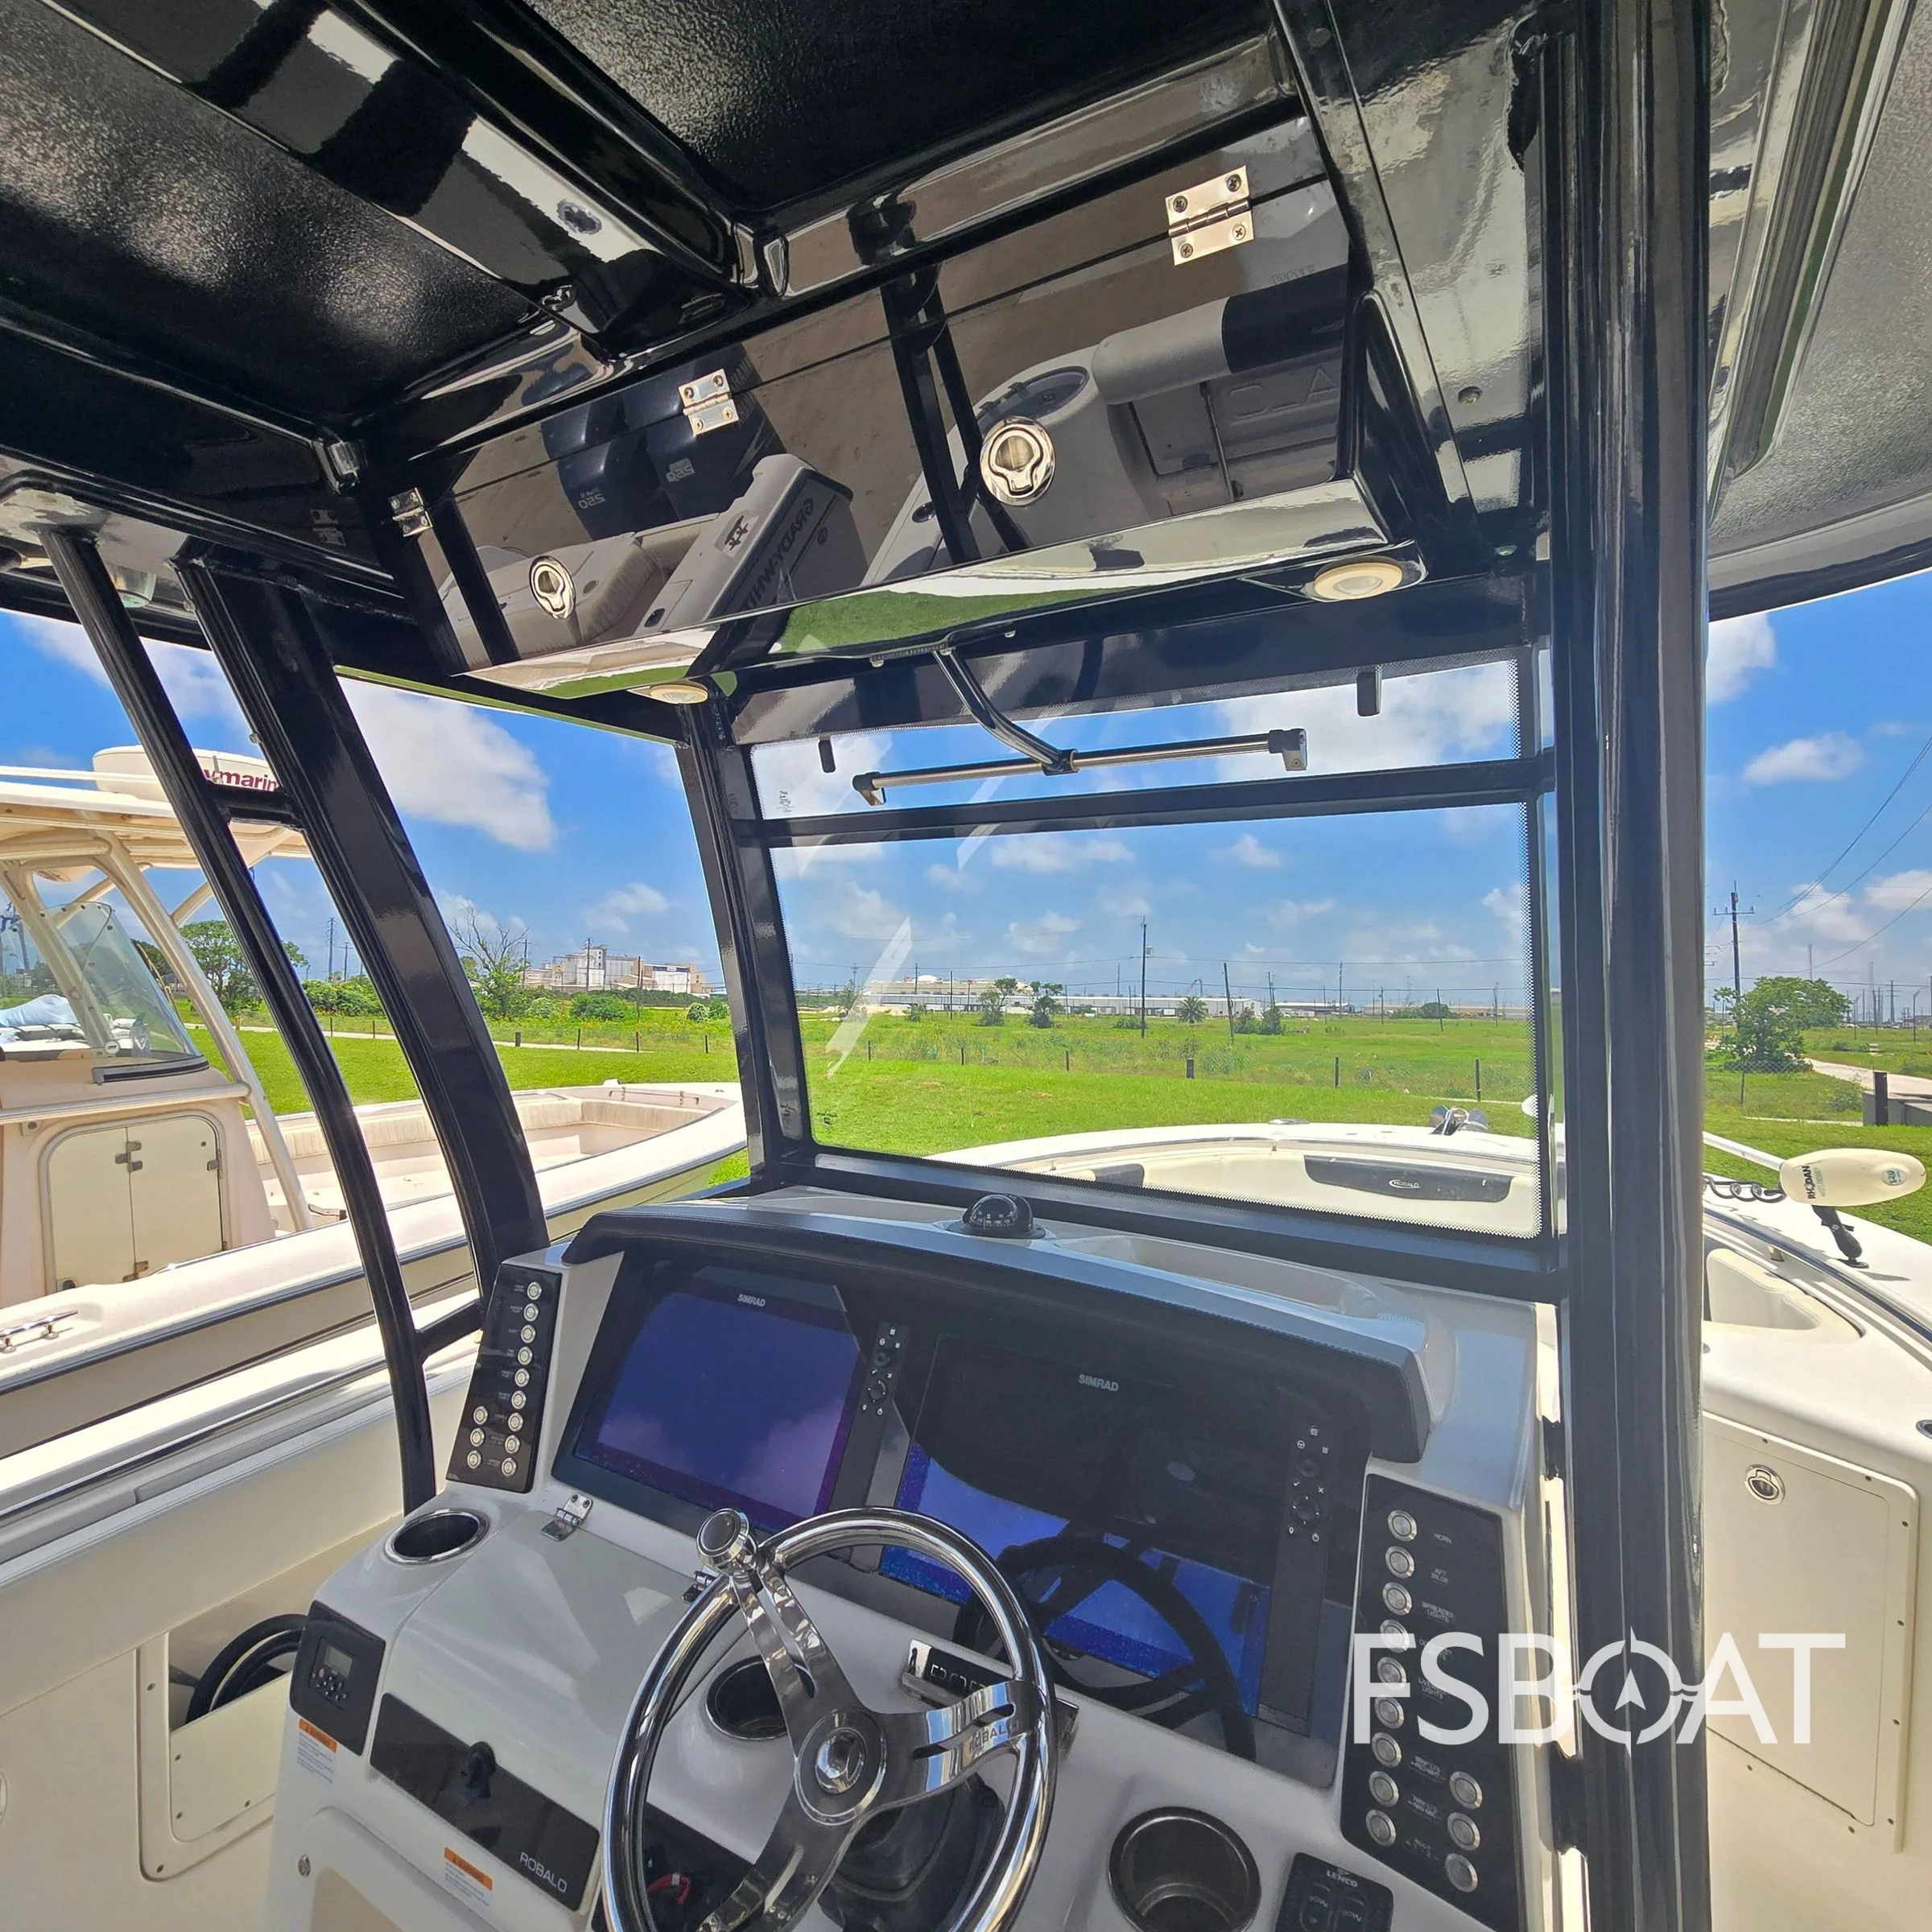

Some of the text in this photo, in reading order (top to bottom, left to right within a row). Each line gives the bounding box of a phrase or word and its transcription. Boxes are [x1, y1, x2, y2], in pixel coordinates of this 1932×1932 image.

[737, 1293, 766, 1308] SIMRAD
[1078, 1373, 1119, 1392] SIMRAD
[1434, 1532, 1452, 1545] HORN
[519, 1852, 568, 1893] ROBALO
[1327, 1869, 1358, 1888] LENCO
